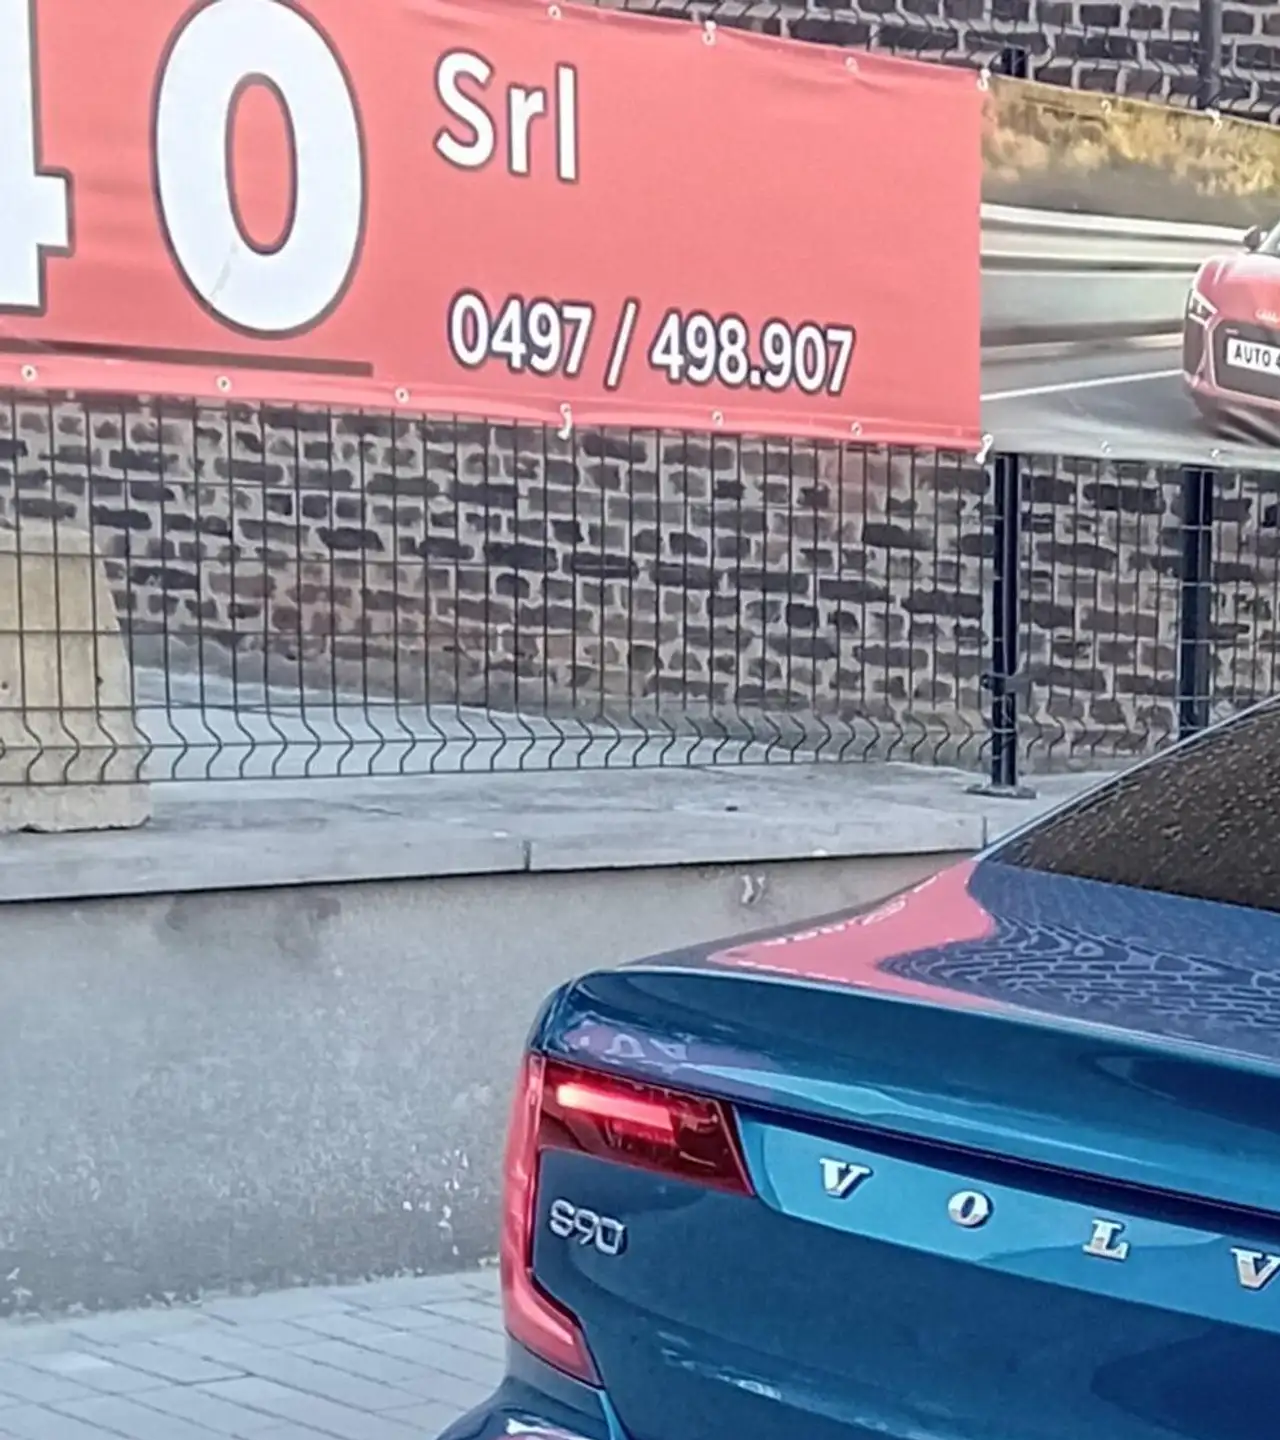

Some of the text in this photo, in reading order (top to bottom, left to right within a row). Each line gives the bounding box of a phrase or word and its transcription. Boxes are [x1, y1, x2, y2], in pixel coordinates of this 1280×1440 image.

[434, 48, 577, 183] Srl
[449, 289, 594, 376] 0497
[649, 310, 856, 395] 498.907
[1234, 343, 1271, 367] AUTO
[549, 1198, 627, 1255] S90
